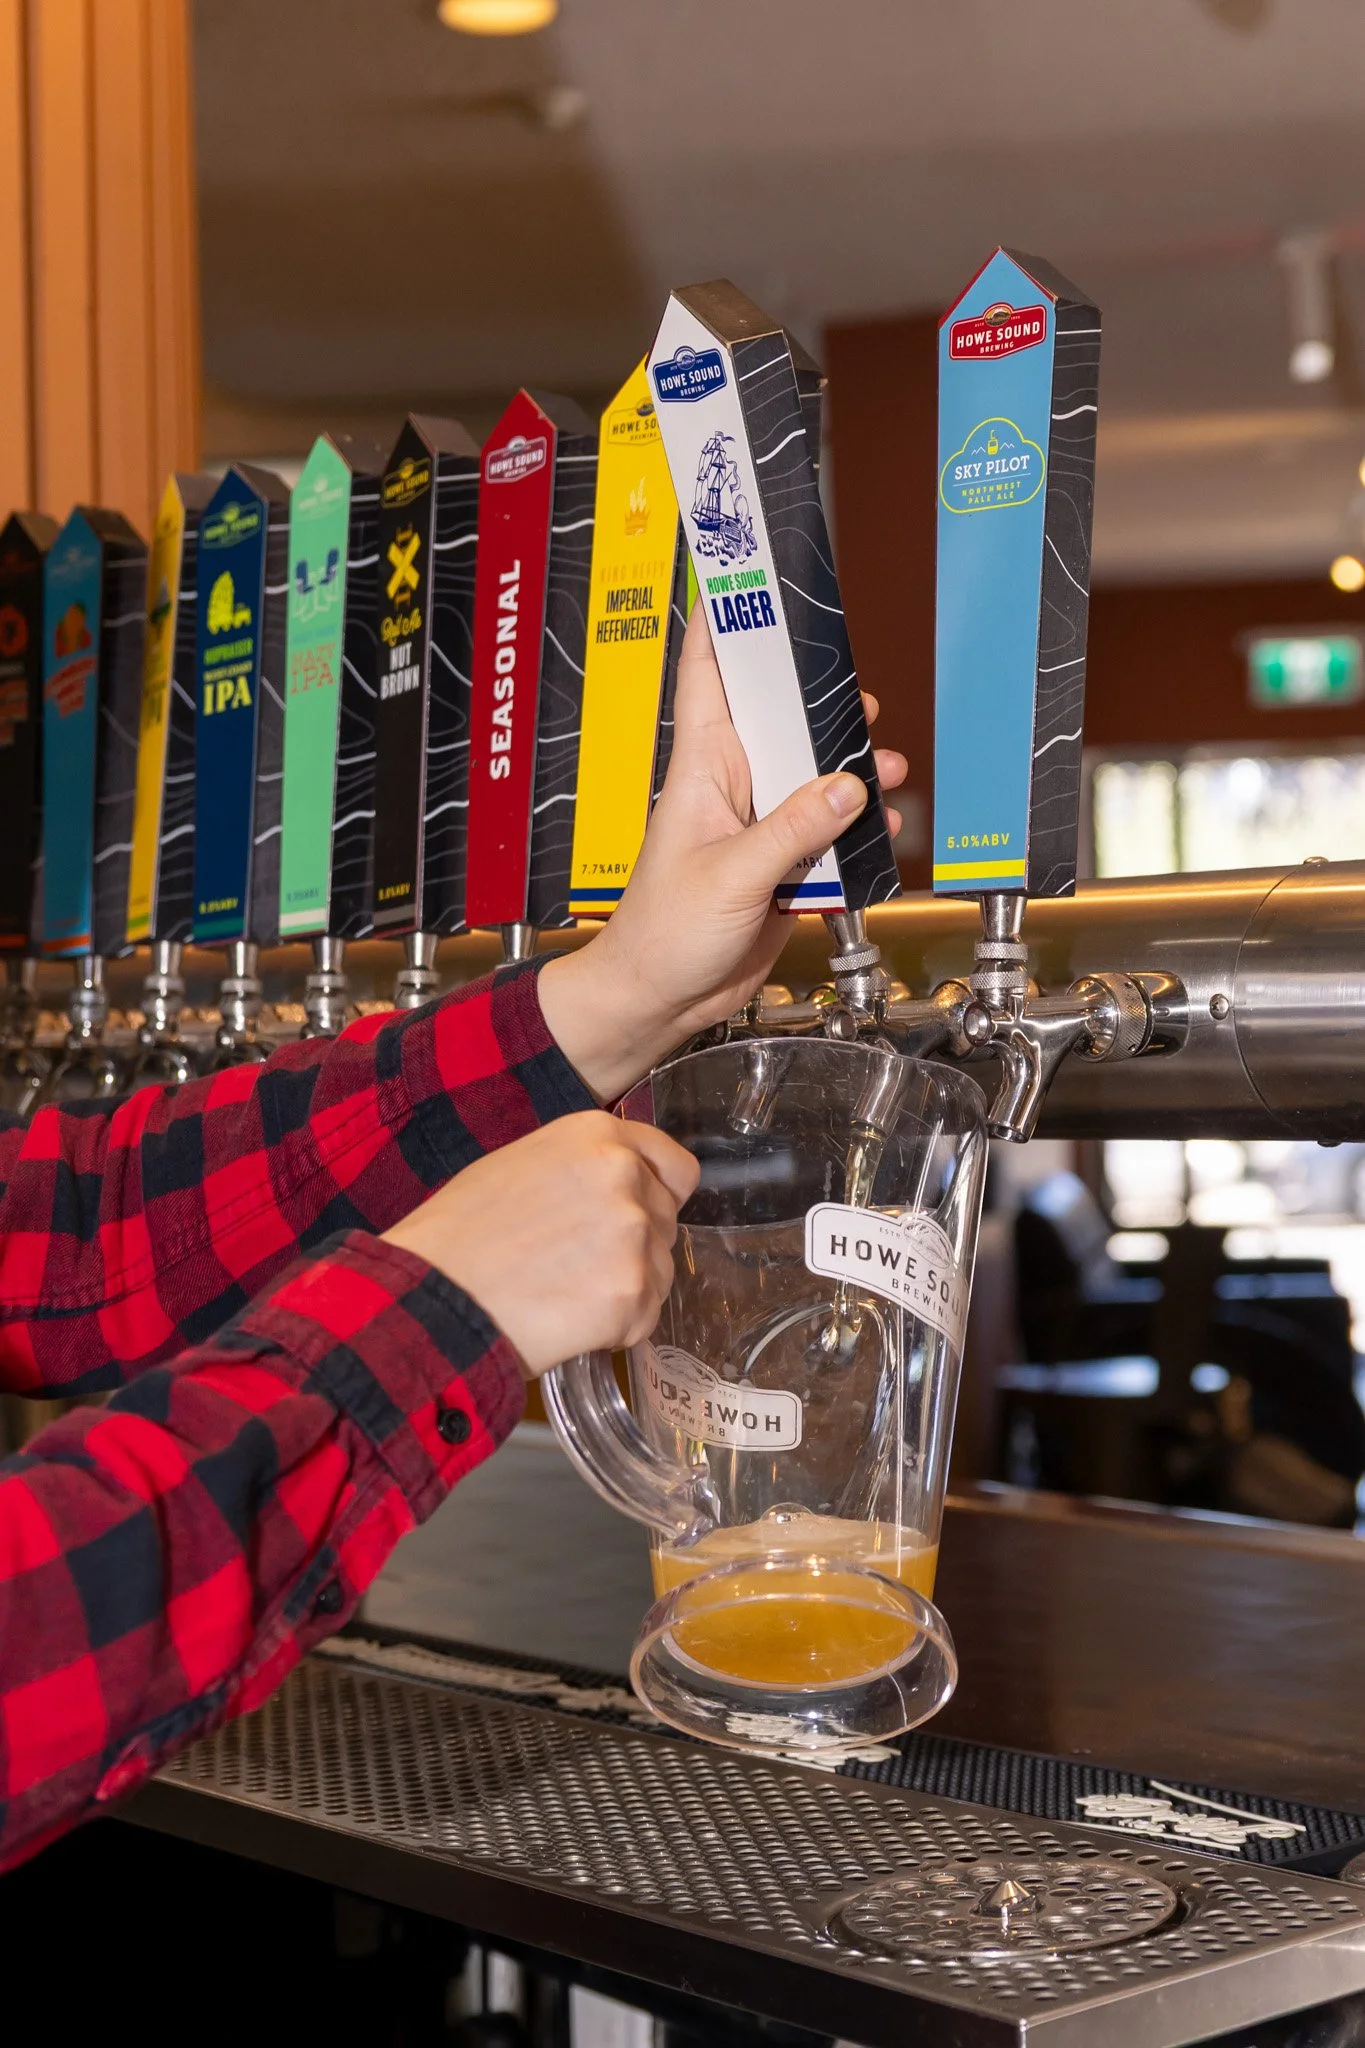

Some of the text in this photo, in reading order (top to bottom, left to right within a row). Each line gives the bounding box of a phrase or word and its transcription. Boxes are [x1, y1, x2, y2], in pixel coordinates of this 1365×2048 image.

[956, 320, 1041, 350] HOWE SOUND
[980, 341, 1014, 353] BREWING
[660, 365, 721, 392] HOWE SOUND
[680, 384, 706, 397] BREWING
[612, 420, 640, 435] HOWE
[515, 448, 544, 467] SOUND
[955, 454, 1030, 480] SKY PILOT
[961, 480, 1021, 497] NORTHWEST
[968, 491, 1015, 504] PALE ALE
[706, 568, 767, 595] HOWE SOUND
[606, 586, 654, 614] IMPERIAL
[711, 590, 777, 634] LAGER
[596, 615, 660, 644] HEFEWEIZEN
[389, 641, 412, 672] NUT
[489, 559, 521, 781] SEASONAL
[290, 661, 335, 694] IPA
[380, 663, 420, 701] BROWN
[203, 675, 253, 716] IPA
[946, 832, 1011, 849] 5.0%ABV
[582, 863, 629, 875] 7.7%ABV
[830, 1233, 961, 1317] HOWE SOU
